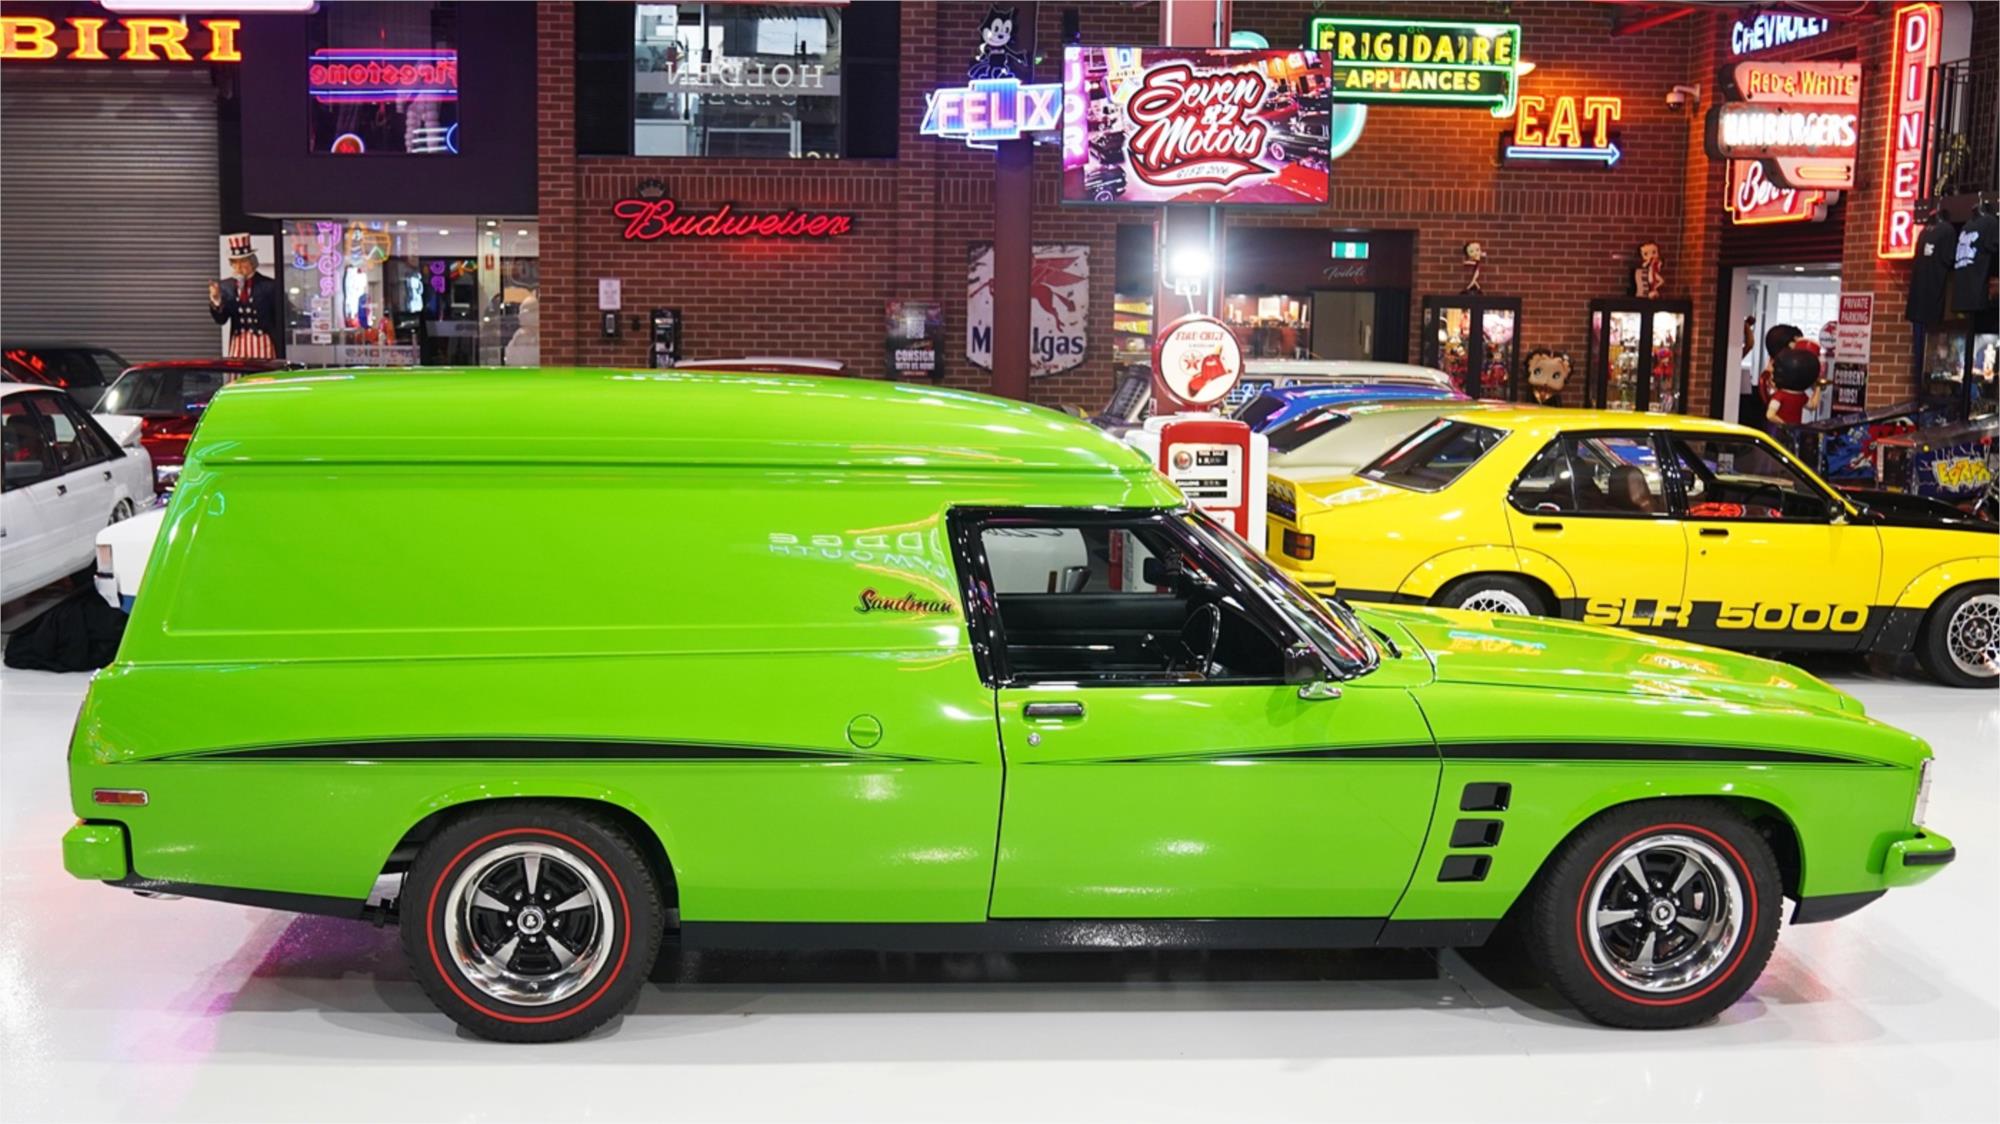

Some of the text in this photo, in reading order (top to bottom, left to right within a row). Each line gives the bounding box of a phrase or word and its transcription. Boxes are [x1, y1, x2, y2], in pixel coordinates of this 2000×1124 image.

[1319, 31, 1512, 64] FRIGIDAIRE
[1133, 70, 1260, 122] Seven
[1345, 69, 1481, 91] APPLIANCES
[1750, 69, 1781, 94] RED
[1801, 71, 1855, 96] WHITE
[936, 90, 1052, 131] FELIX
[1201, 103, 1234, 126] 82
[1515, 96, 1621, 148] EAT
[1136, 115, 1259, 168] Motors
[1722, 112, 1857, 148] HAMBURGERS
[1890, 14, 1927, 247] DINER
[613, 200, 852, 239] Budweiser
[972, 326, 1084, 362] Mlgas
[855, 588, 953, 613] Sandman
[1584, 598, 1869, 632] SLR 5000
